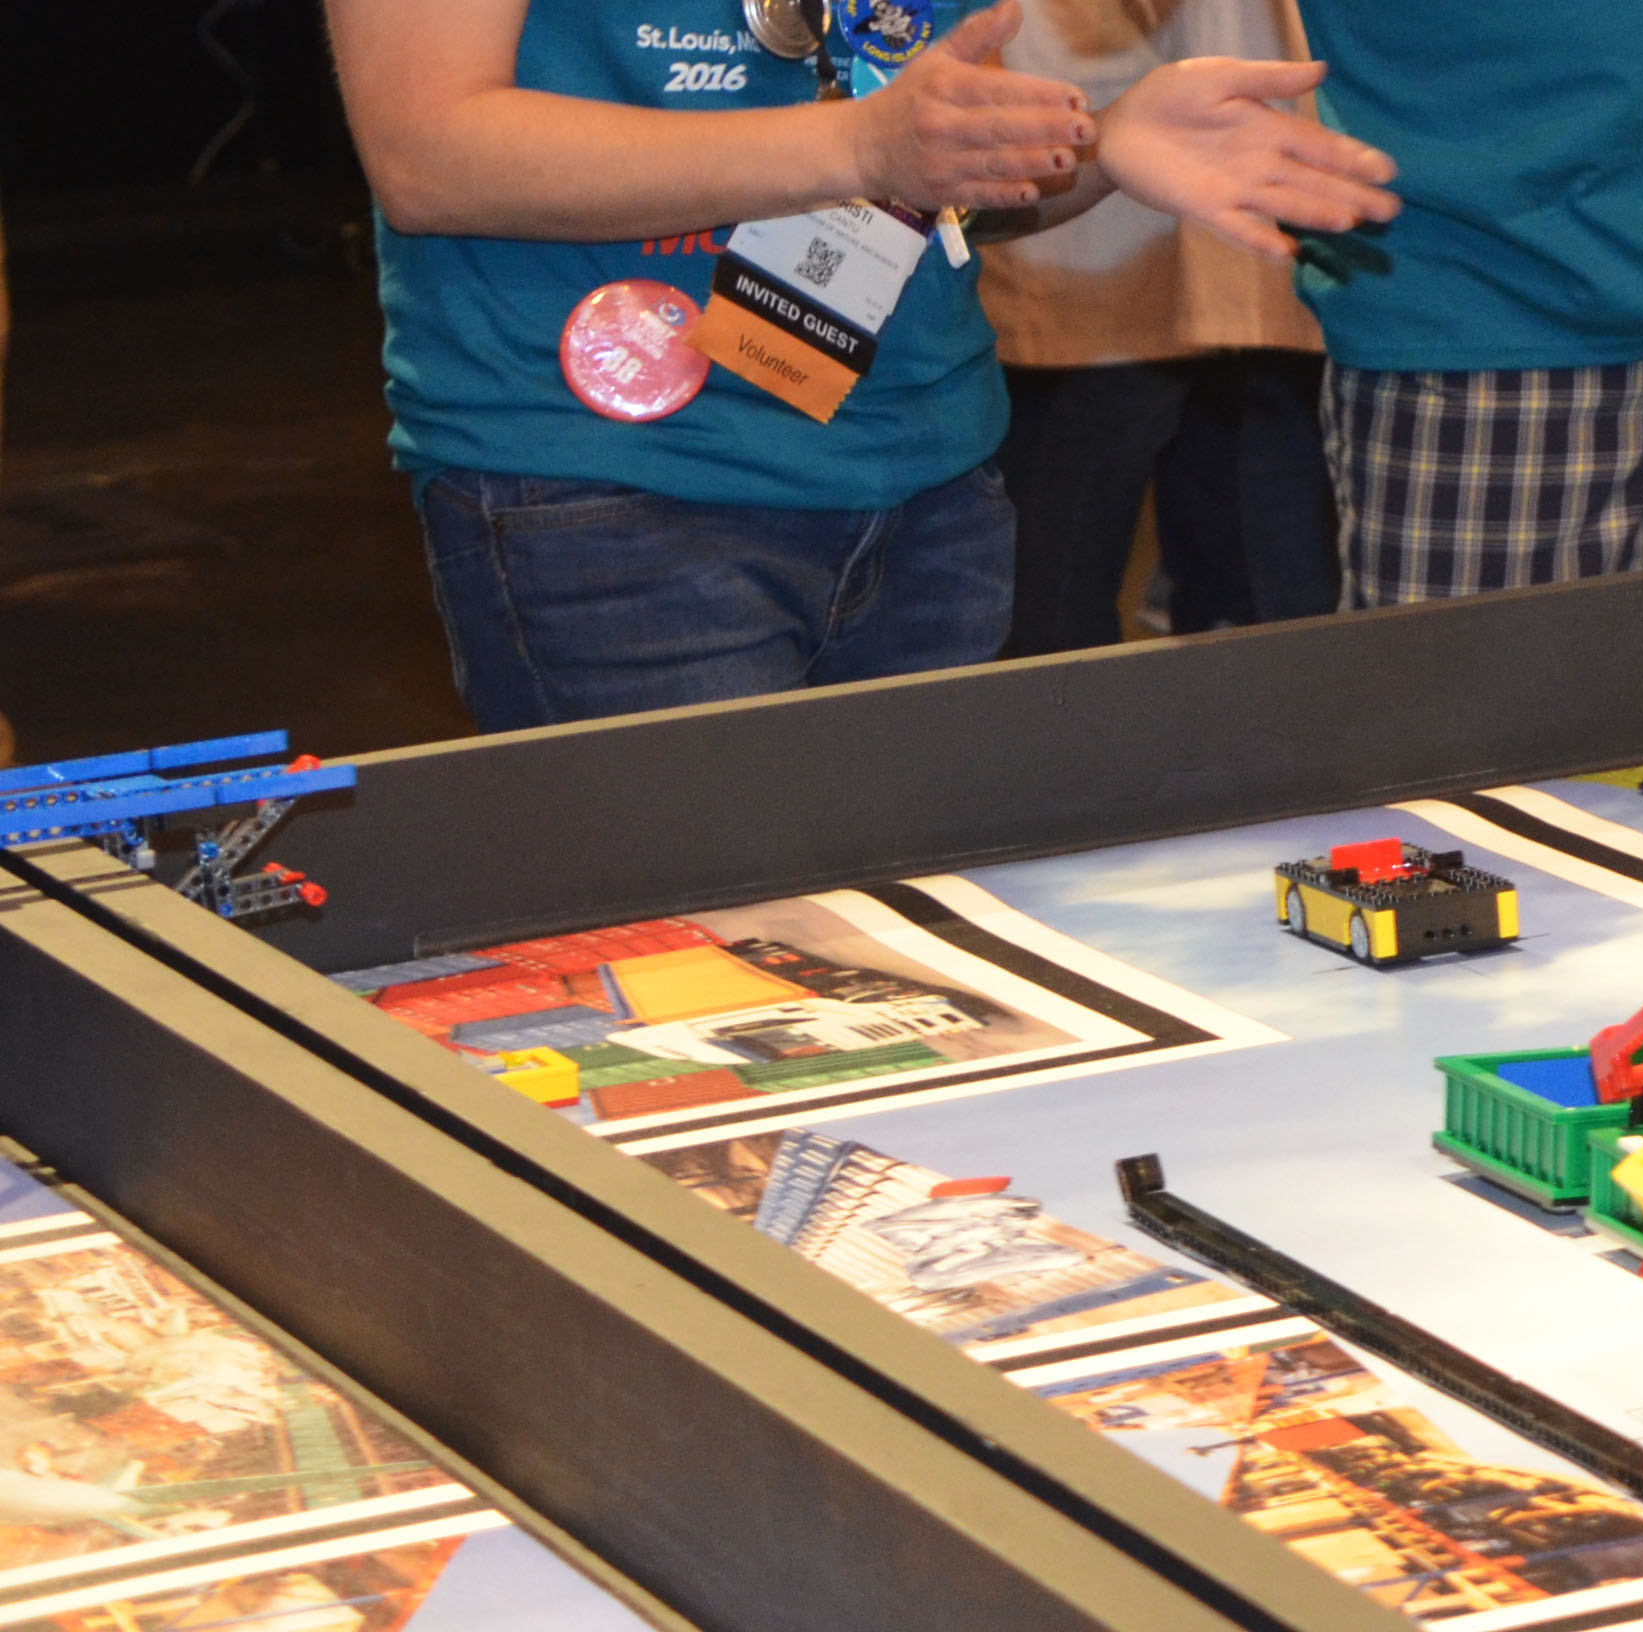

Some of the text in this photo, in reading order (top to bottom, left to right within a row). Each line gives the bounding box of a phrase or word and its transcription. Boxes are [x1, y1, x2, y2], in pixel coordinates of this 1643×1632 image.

[668, 25, 739, 53] Louis,
[664, 61, 748, 92] 2016
[735, 273, 860, 355] INVITED GUEST
[737, 332, 809, 386] Volunteer
